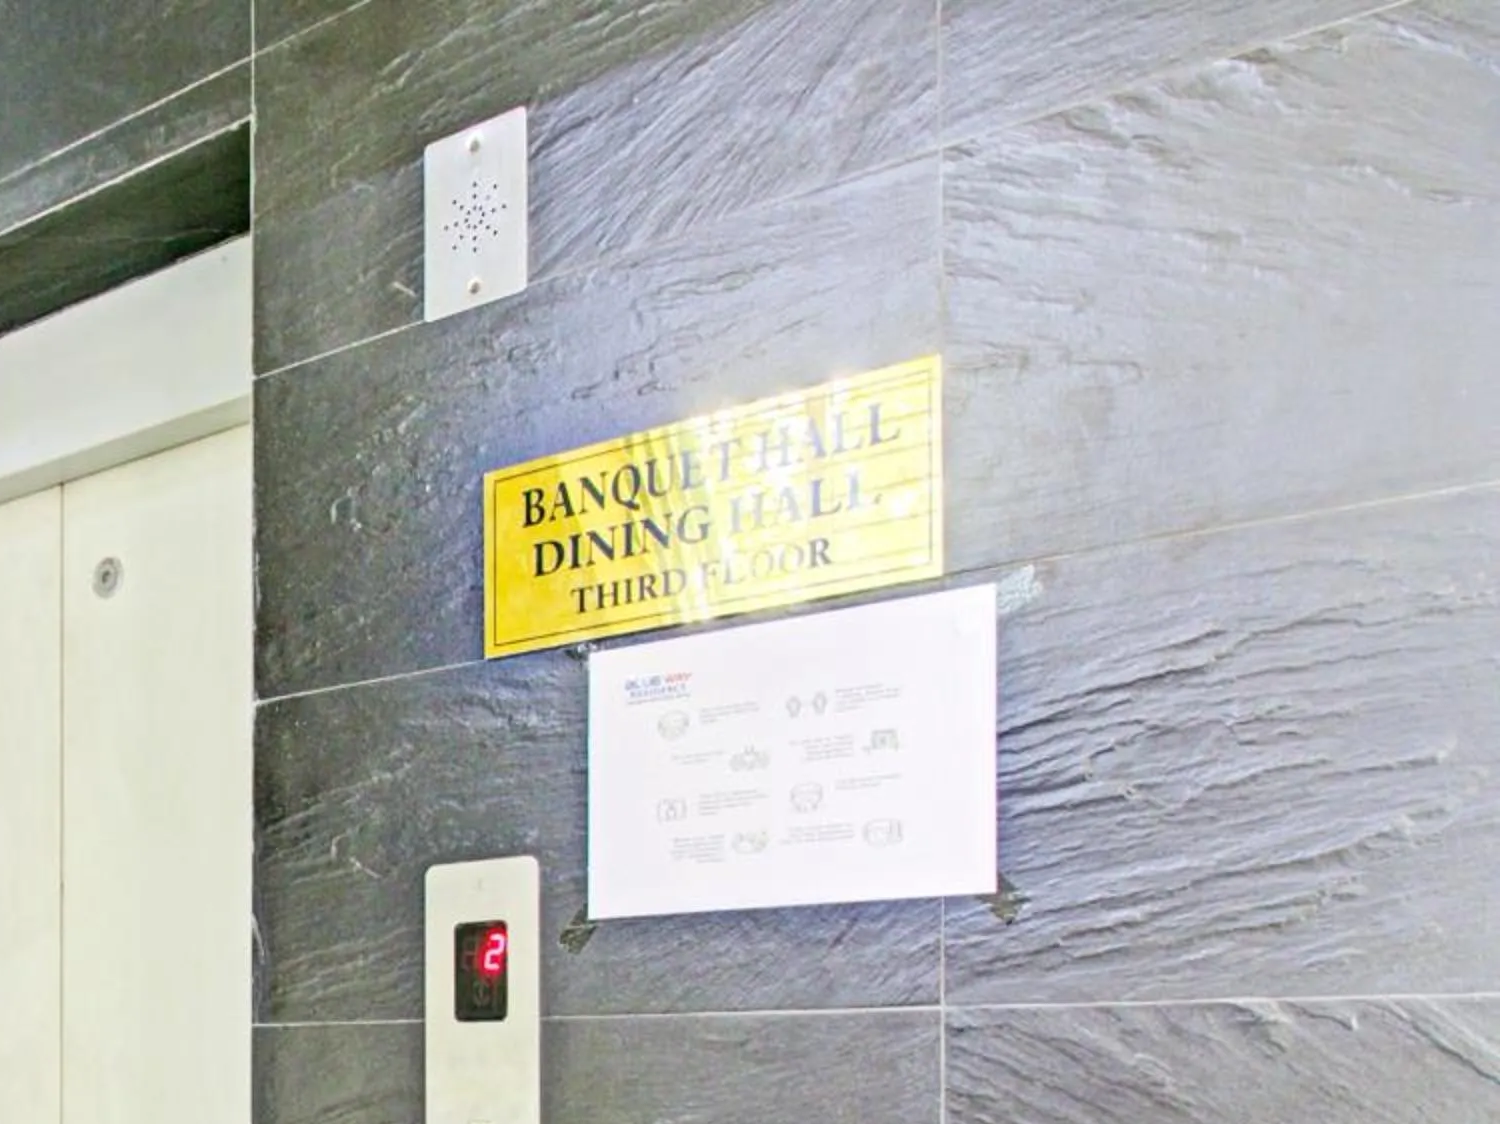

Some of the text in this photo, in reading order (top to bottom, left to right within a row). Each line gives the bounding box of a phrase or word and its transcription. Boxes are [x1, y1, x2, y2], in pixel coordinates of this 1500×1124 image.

[521, 402, 901, 529] BANQUET HALL
[532, 504, 711, 578] DINING
[570, 537, 833, 615] THIRD FLOOR
[484, 932, 505, 970] 2
